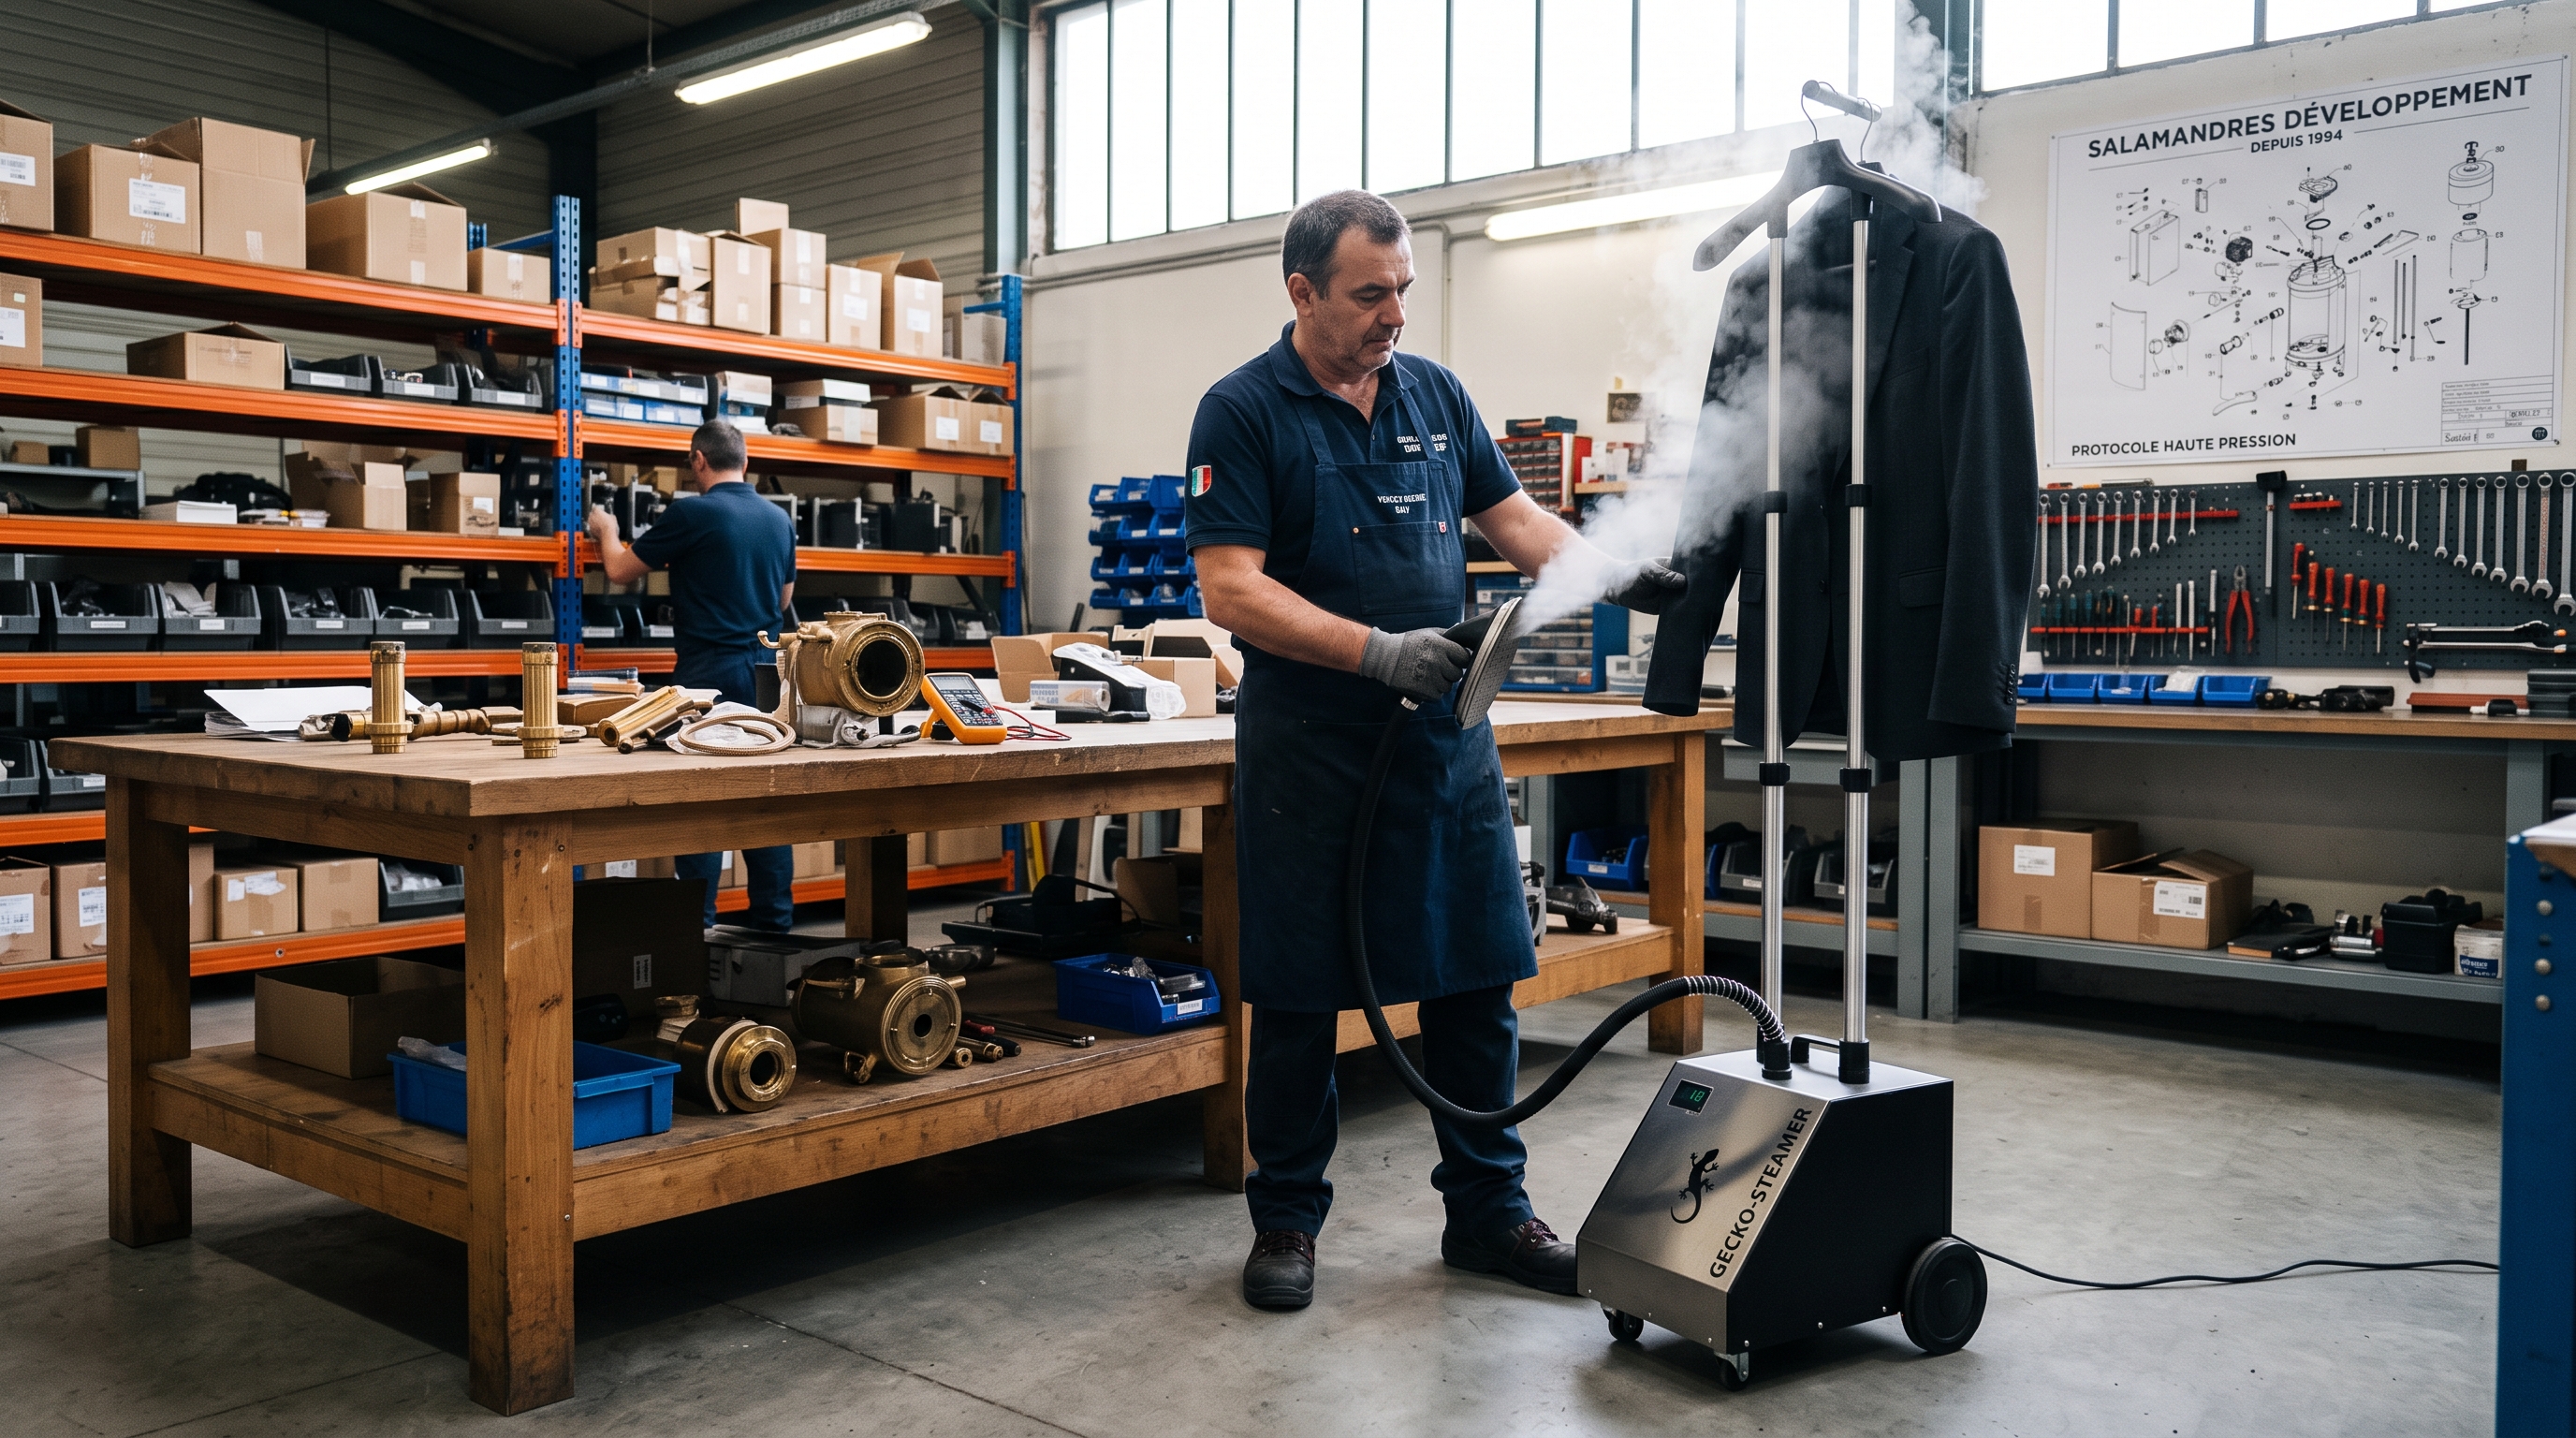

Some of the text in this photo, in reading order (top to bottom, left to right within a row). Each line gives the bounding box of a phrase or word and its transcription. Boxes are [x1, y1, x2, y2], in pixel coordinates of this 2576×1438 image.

[2088, 74, 2532, 158] SALAMANDRES DÉVELOPPEMENT
[2250, 129, 2343, 154] DEPUIS 1994
[2071, 433, 2296, 457] PROTOCOLE HAUTE PRESSION
[1709, 1108, 1813, 1279] GECKO-STEAMER
